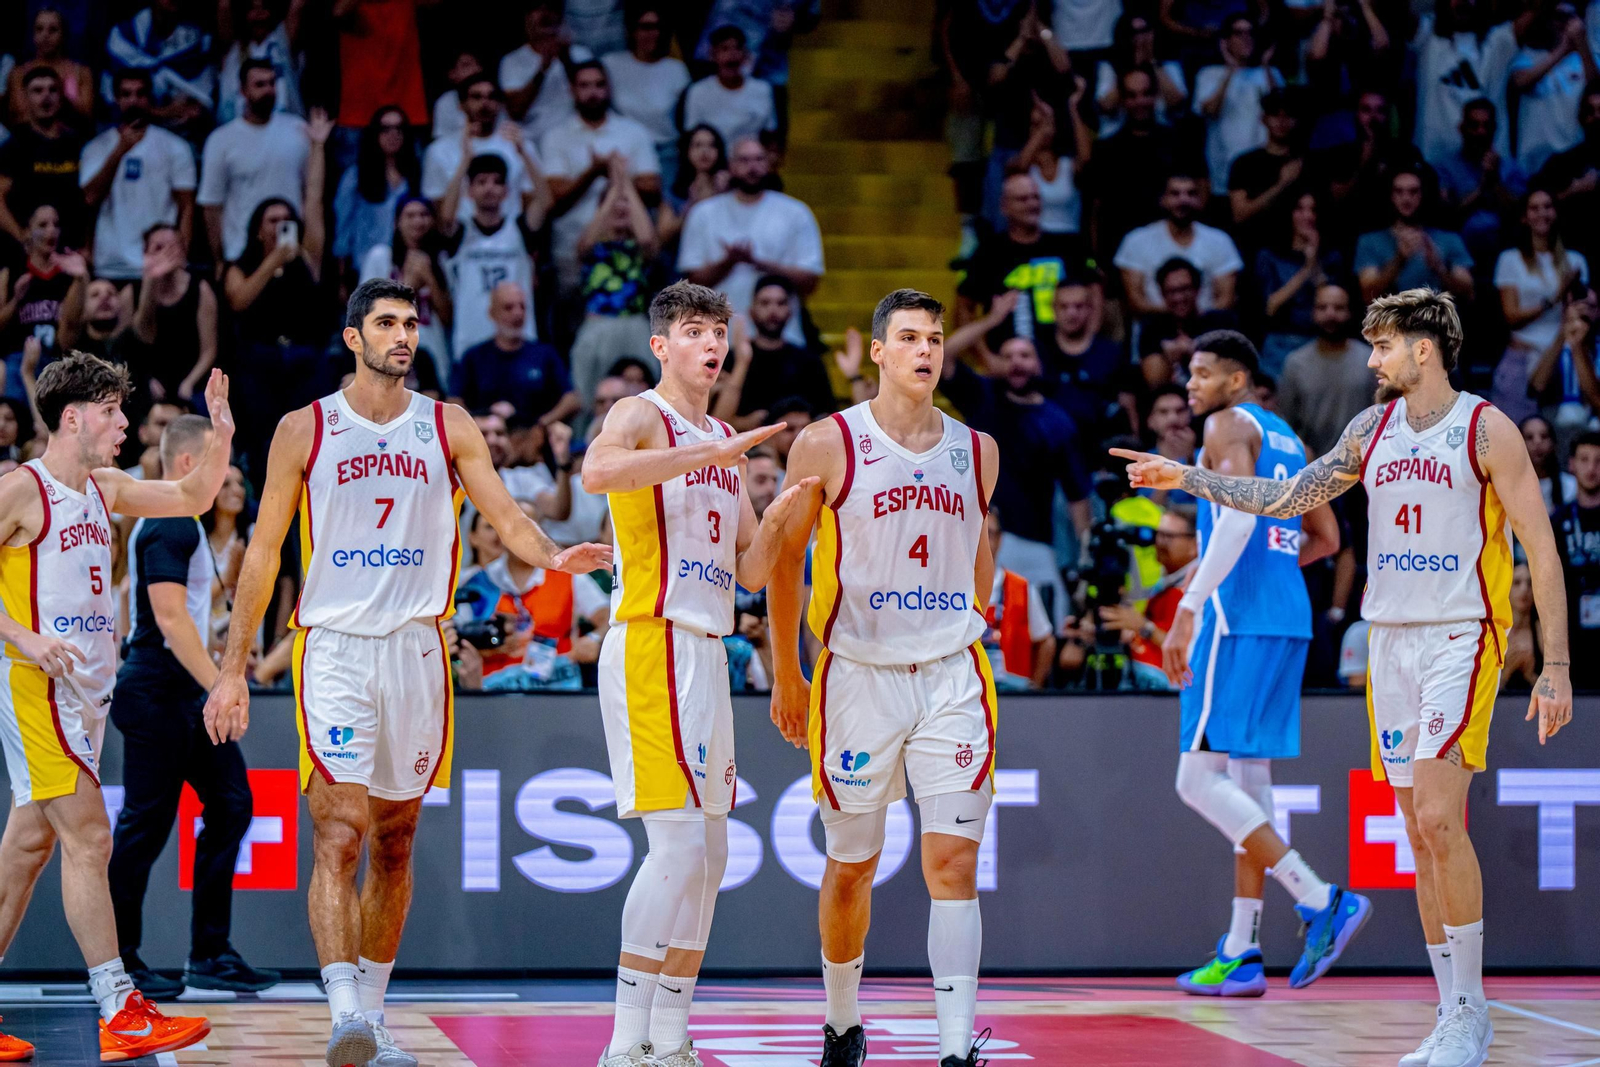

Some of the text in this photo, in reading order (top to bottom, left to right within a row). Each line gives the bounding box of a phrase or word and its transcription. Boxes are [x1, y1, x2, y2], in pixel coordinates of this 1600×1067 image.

[337, 450, 429, 486] ESPAÑA
[1375, 456, 1453, 489] ESPAÑA
[374, 497, 395, 529] 7
[873, 483, 965, 521] ESPAÑA
[707, 510, 721, 544] 3
[1395, 503, 1422, 534] 41
[332, 543, 425, 568] endesa
[908, 534, 929, 568] 4
[1378, 548, 1459, 572] endesa
[89, 566, 103, 595] 5
[678, 558, 733, 591] endesa
[869, 585, 967, 611] endesa
[53, 610, 114, 633] endes
